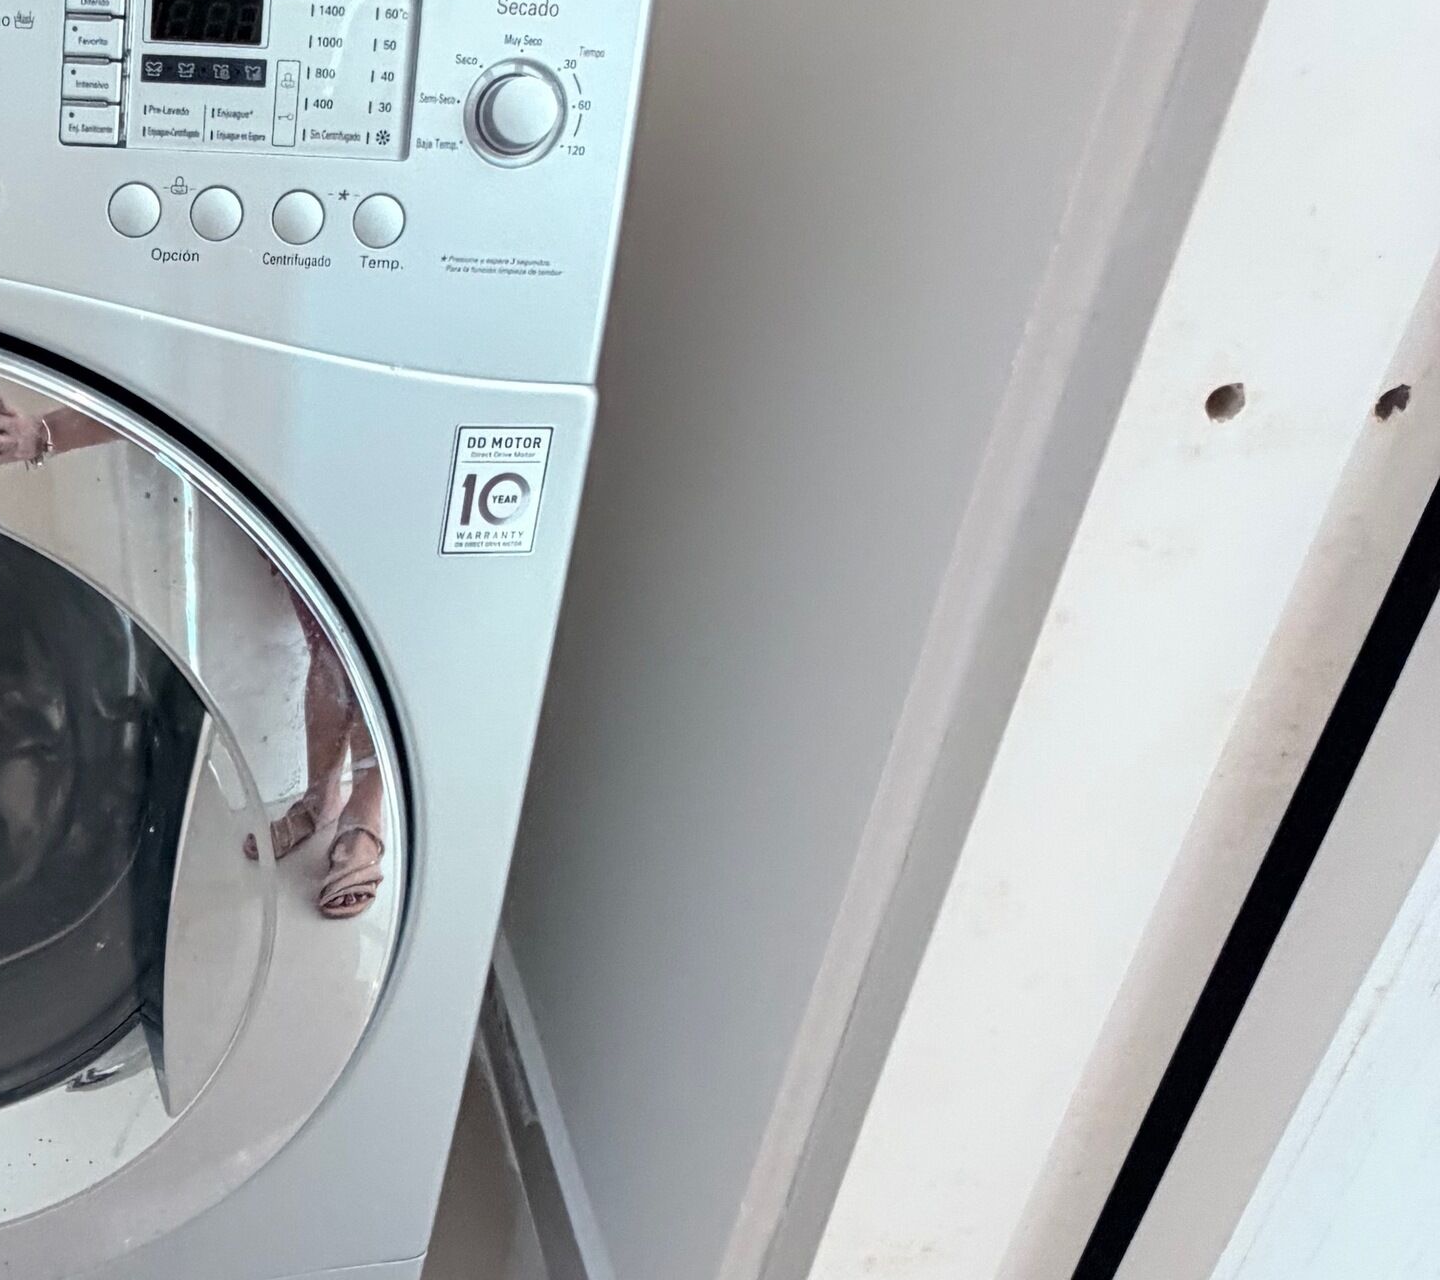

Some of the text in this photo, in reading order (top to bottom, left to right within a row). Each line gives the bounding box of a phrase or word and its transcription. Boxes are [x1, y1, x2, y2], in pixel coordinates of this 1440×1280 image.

[319, 5, 345, 18] 1400
[78, 36, 108, 46] Favorito
[317, 36, 343, 49] 1000
[383, 40, 397, 52] 50
[504, 34, 543, 47] Muy Seco
[579, 46, 605, 58] Tiempo
[455, 54, 478, 66] Seco
[564, 58, 577, 70] 30
[315, 68, 336, 80] 800
[380, 71, 395, 83] 40
[75, 80, 109, 90] Intensivo
[313, 98, 334, 111] 400
[419, 93, 456, 105] Semi-Seco
[378, 101, 392, 113] 30
[578, 100, 591, 111] 60
[416, 138, 459, 151] Baja Temp.
[567, 145, 586, 157] 120
[151, 247, 200, 263] Opción
[262, 251, 332, 270] Centrifugado
[360, 255, 405, 272] Temp.
[467, 437, 542, 449] DD MOTOR
[460, 472, 531, 526] 10
[492, 495, 518, 504] YEAR
[456, 531, 525, 540] WARRANTY
